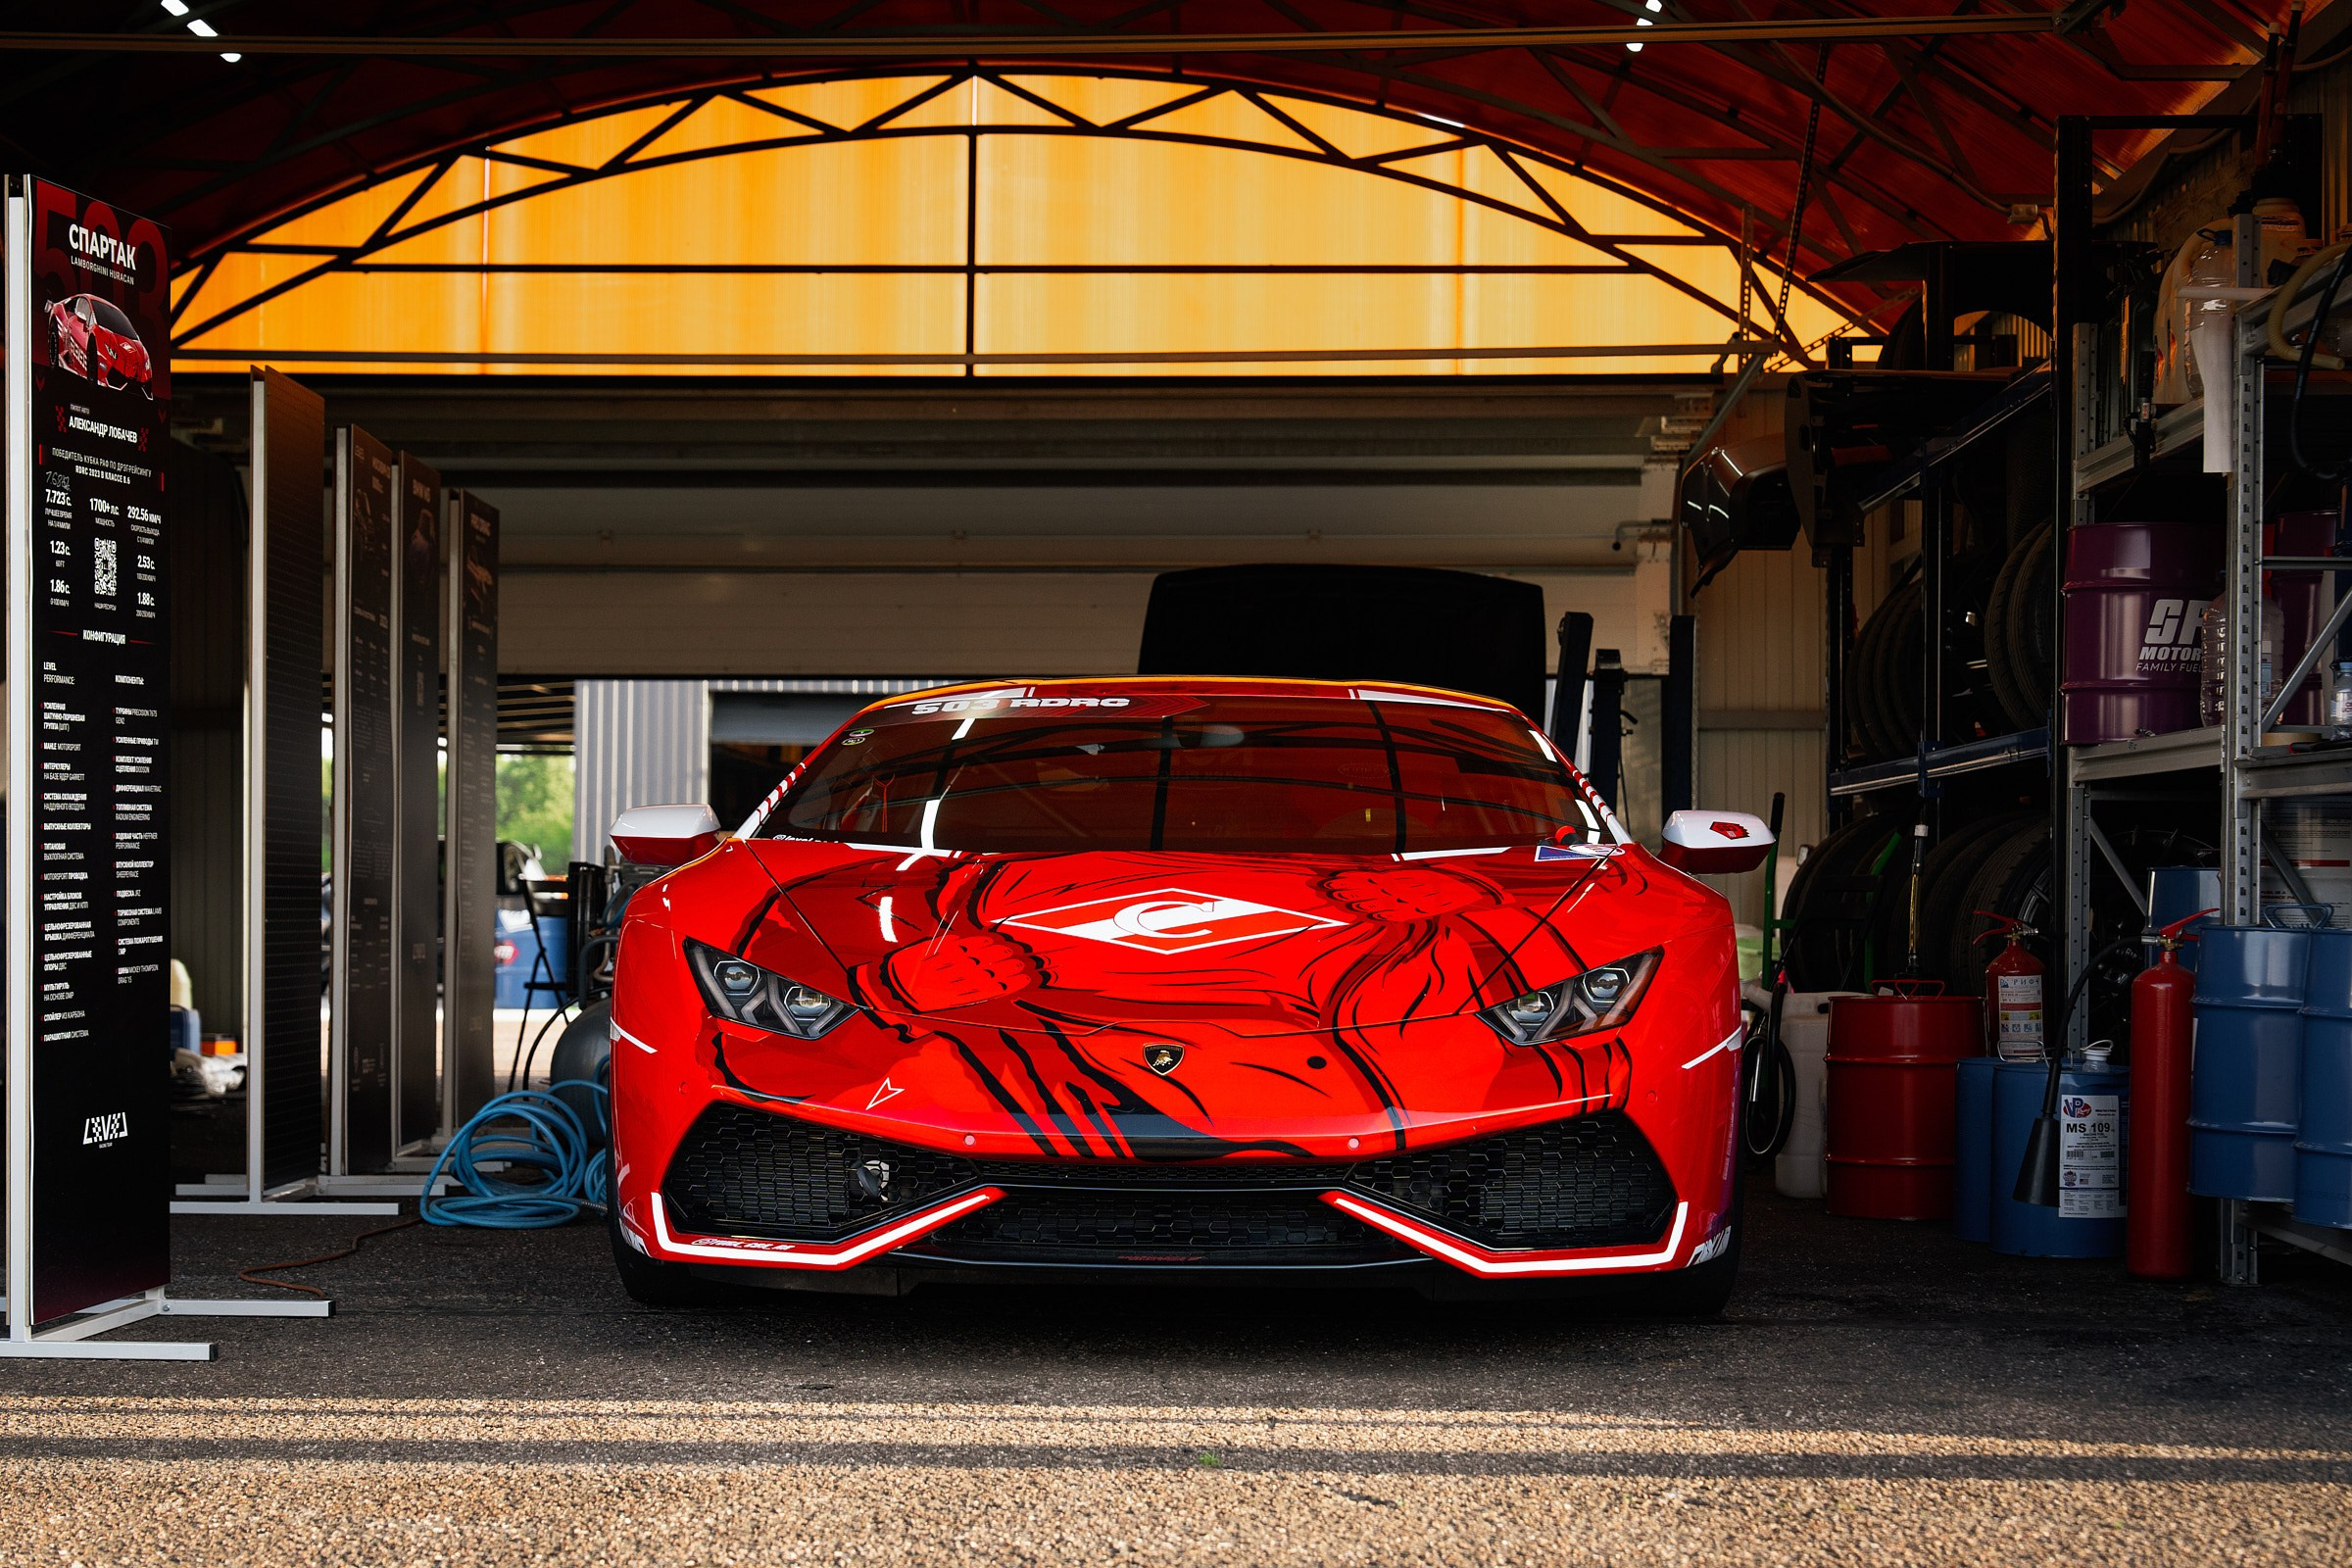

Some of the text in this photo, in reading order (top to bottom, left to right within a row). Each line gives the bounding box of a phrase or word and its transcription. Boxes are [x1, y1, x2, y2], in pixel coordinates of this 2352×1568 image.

[69, 223, 136, 270] СПАРТАК
[71, 256, 134, 285] LAMBORGHINI HURACAN
[69, 416, 137, 443] АЛЕКСАНДР ЛОБАЧЕВ
[52, 448, 83, 462] ПОБЕДИТЕЛЬ
[84, 456, 99, 466] КУБКА
[110, 461, 117, 469] ПО
[75, 466, 88, 475] RDRC
[89, 468, 100, 477] 2023
[105, 471, 122, 482] КЛАССЕ
[46, 489, 66, 505] 7.723
[90, 498, 110, 513] 1700+
[127, 506, 148, 520] 292.56
[50, 540, 65, 555] 1.23
[137, 555, 150, 568] 2.53
[50, 579, 65, 593] 1.86
[83, 630, 125, 645] КОНФИГУРАЦИЯ
[44, 662, 56, 670] LEVEL
[2136, 662, 2178, 672] FAMILY
[912, 698, 1130, 714] 503 RDRC
[2064, 1098, 2083, 1117] VP
[2067, 1123, 2110, 1133] MS 109
